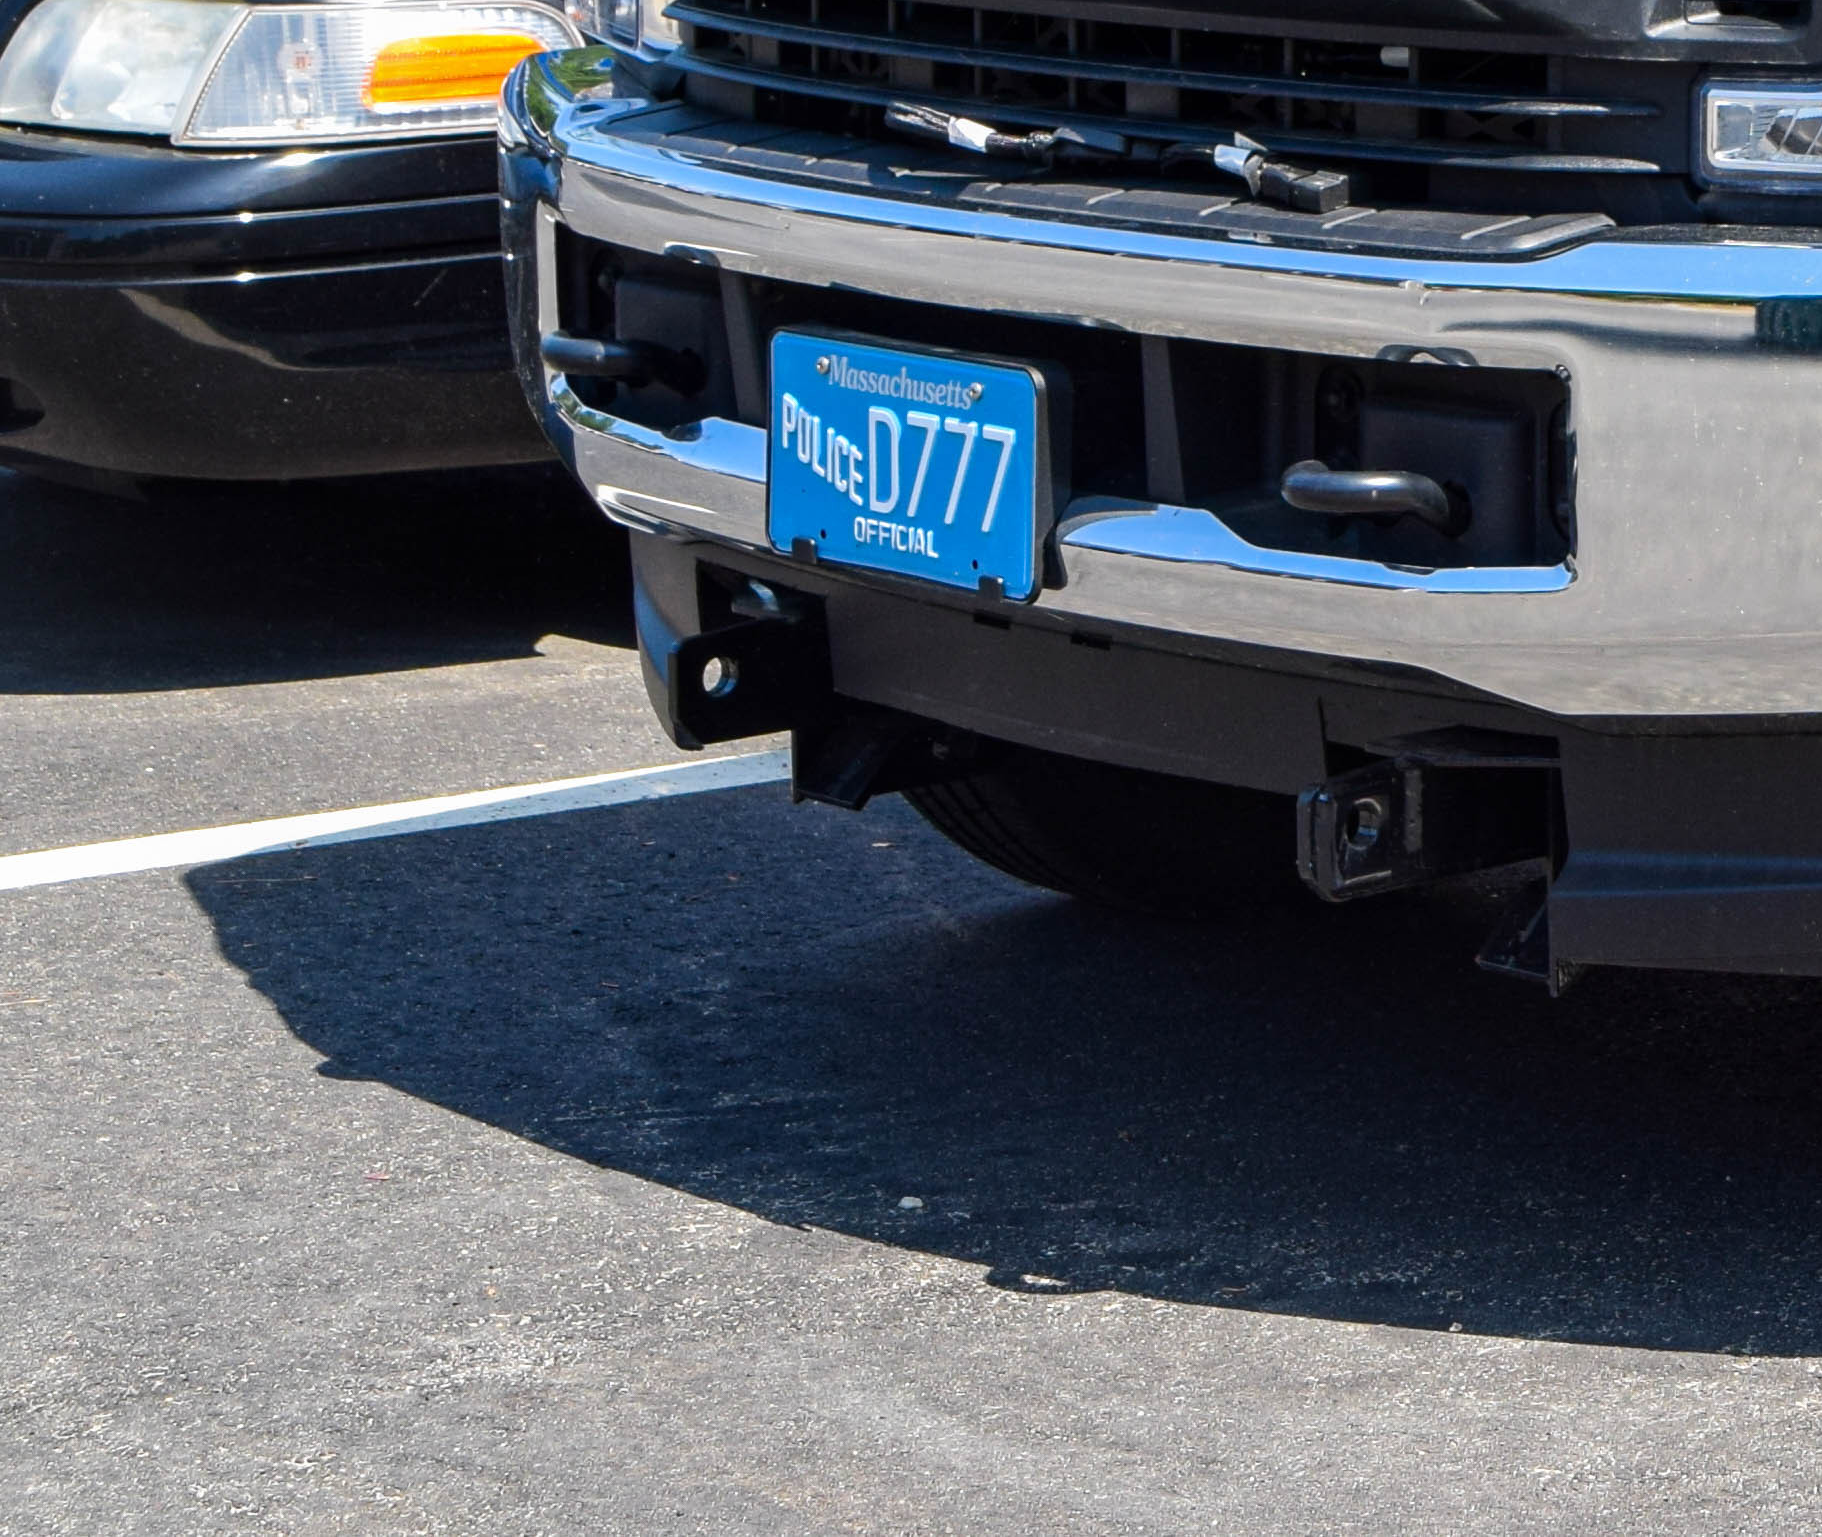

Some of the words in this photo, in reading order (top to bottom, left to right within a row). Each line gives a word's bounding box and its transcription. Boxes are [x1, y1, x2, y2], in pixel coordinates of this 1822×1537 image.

[829, 354, 972, 410] Massachusetts
[782, 392, 863, 506] POLICE
[869, 406, 1015, 532] D777
[854, 516, 939, 558] OFFICIAL
